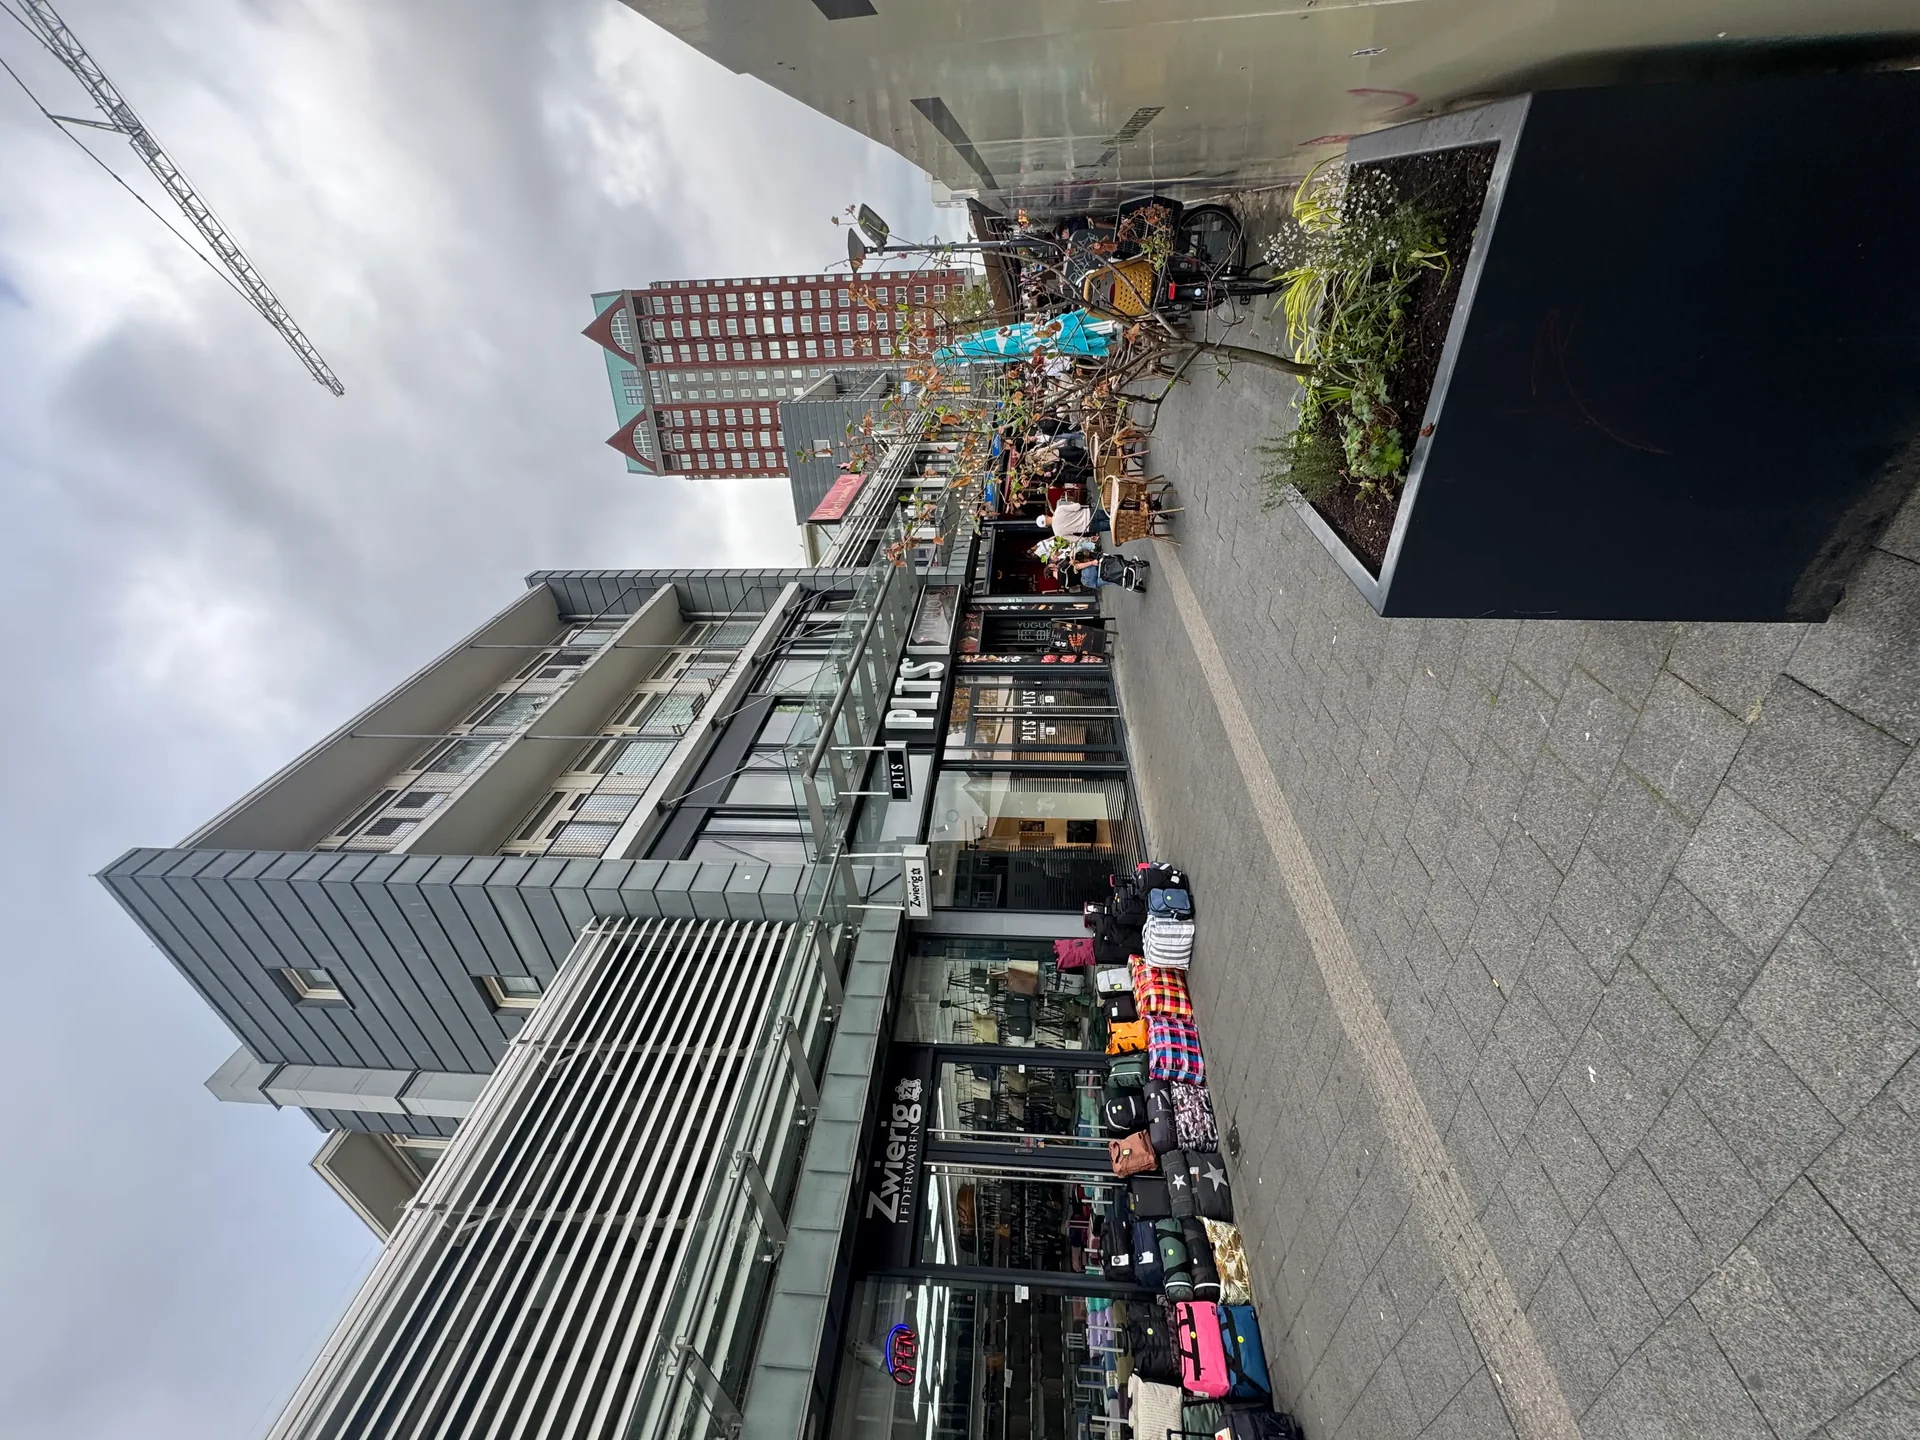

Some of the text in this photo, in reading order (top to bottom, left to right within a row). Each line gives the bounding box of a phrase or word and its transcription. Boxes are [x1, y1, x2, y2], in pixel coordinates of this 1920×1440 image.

[918, 600, 942, 633] YUGUO
[884, 660, 945, 729] PLTS
[1022, 720, 1036, 740] PLTS
[890, 763, 905, 788] PLTS
[908, 876, 923, 908] Zwierig
[865, 1103, 922, 1223] Zwierig
[898, 1125, 920, 1224] LEDERWAREN
[893, 1330, 916, 1385] OPEN
